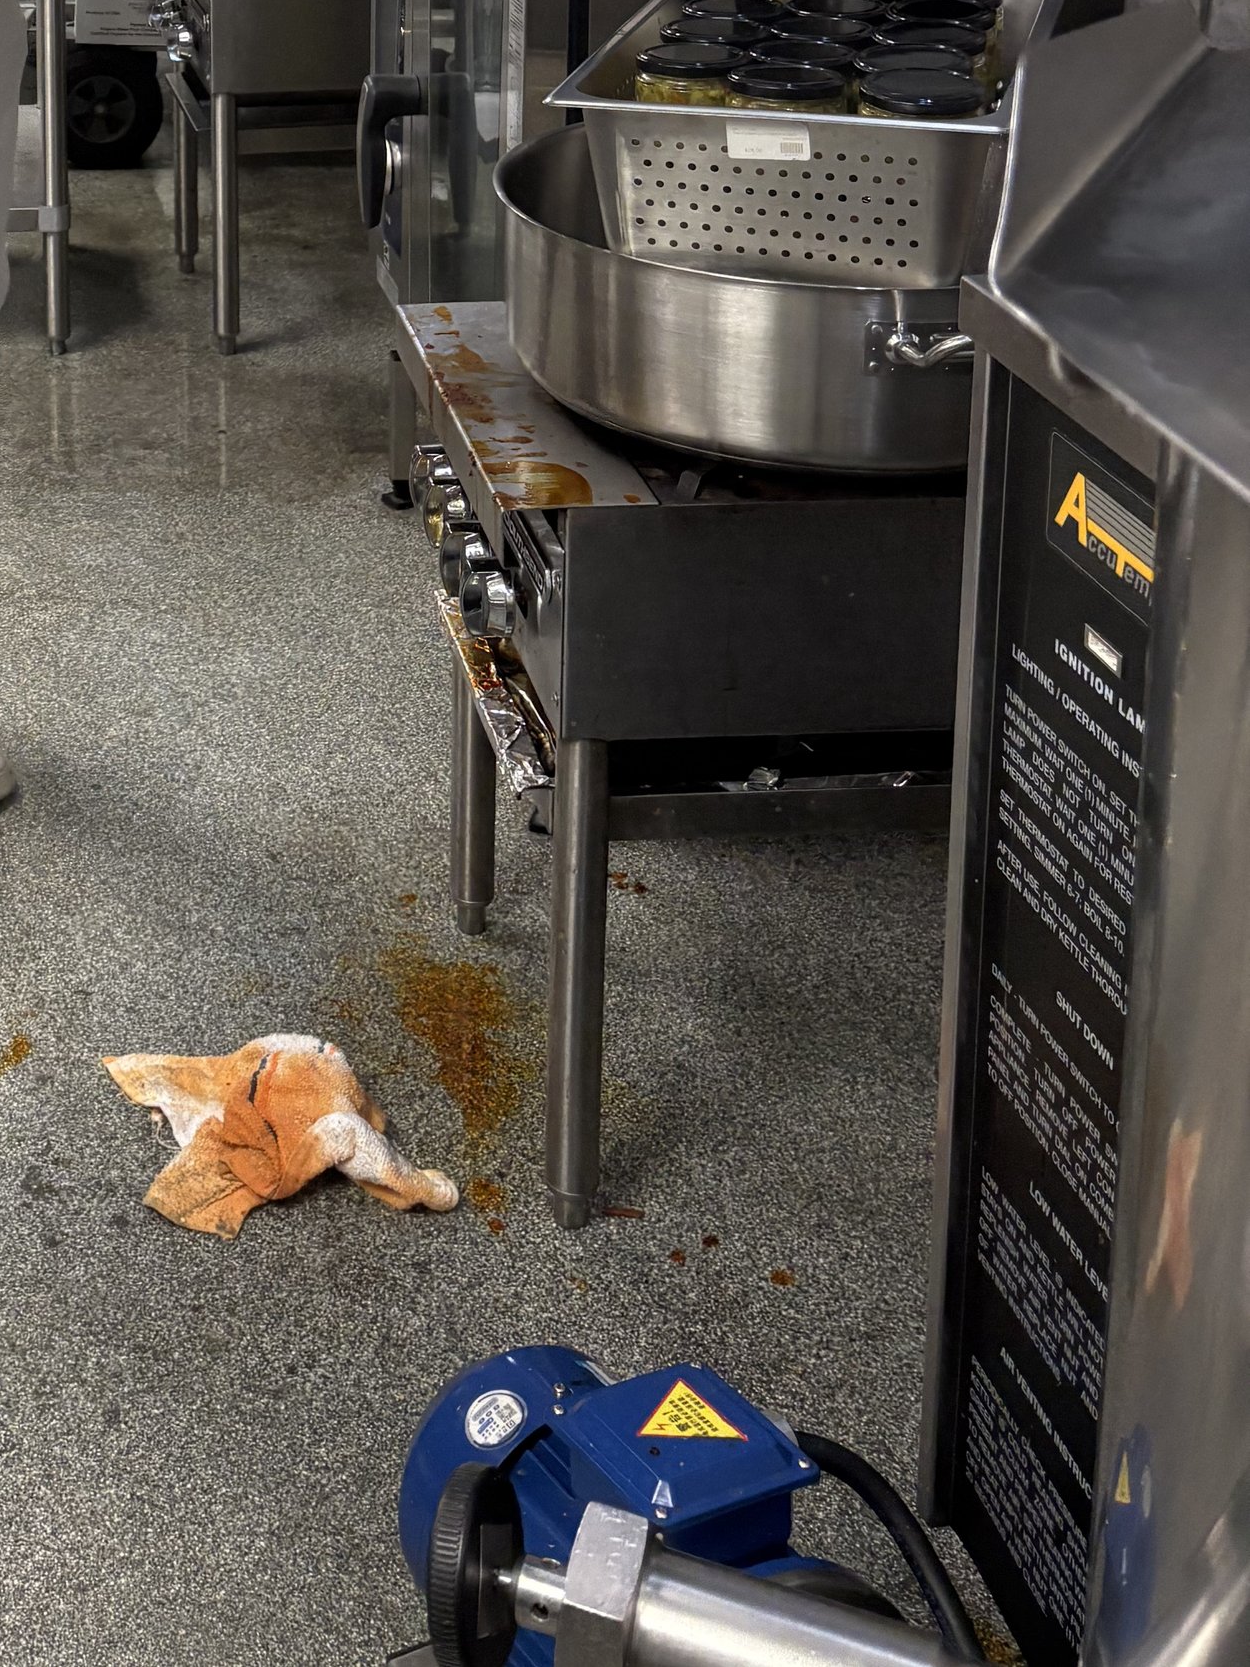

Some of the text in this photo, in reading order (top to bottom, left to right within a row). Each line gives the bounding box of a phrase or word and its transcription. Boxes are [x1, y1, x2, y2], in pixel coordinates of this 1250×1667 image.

[1055, 472, 1155, 607] AccuTem
[1012, 644, 1054, 695] LIGHTING
[1061, 691, 1119, 758] OPERATING
[1054, 639, 1113, 705] IGNITION
[1002, 739, 1052, 800] THERMOSTAT.
[1055, 794, 1075, 823] WAIT
[1077, 817, 1096, 846] ONE
[1097, 839, 1108, 858] (1)
[1003, 721, 1135, 866] LAMP DOES NOT TURN ON
[1005, 685, 1025, 713] TURN
[1027, 707, 1056, 744] POWER
[1057, 737, 1090, 778] SWITCH
[1092, 772, 1107, 796] ON.
[1109, 789, 1126, 815] SET
[999, 788, 1126, 935] SET THERMOSTAT TO DESIRED
[1001, 757, 1051, 818] THERMOSTAT
[1052, 811, 1064, 833] ON
[1066, 825, 1092, 862] AGAIN
[1094, 855, 1112, 883] FOR
[996, 855, 1021, 892] CLEAN
[1022, 886, 1039, 913] AND
[1040, 907, 1056, 933] DRY
[1058, 927, 1089, 971] KETTLE
[997, 838, 1021, 874] AFTER
[1043, 890, 1076, 937] FOLLOW
[1078, 931, 1122, 989] CLEANING
[990, 994, 1031, 1054] COMPLETE
[1043, 1063, 1065, 1098] TURN
[1069, 1096, 1100, 1143] POWER
[991, 962, 1114, 1124] DAILY TURN POWER SWITCH TO
[1055, 990, 1113, 1069] SHUT DOWN
[987, 1045, 1012, 1085] PANEL
[1013, 1079, 1028, 1107] AND
[1031, 1103, 1053, 1140] TURN
[1054, 1134, 1072, 1165] DIAL
[1074, 1161, 1086, 1185] ON
[989, 1011, 1115, 1183] POSITION. TURN OFF POWER
[1035, 1090, 1067, 1140] REMOVE
[1072, 1139, 1091, 1171] LEFT
[1029, 1180, 1049, 1219] LOW
[1051, 1211, 1082, 1265] WATER
[1000, 1345, 1014, 1376] AIR
[1015, 1369, 1052, 1437] VENTING
